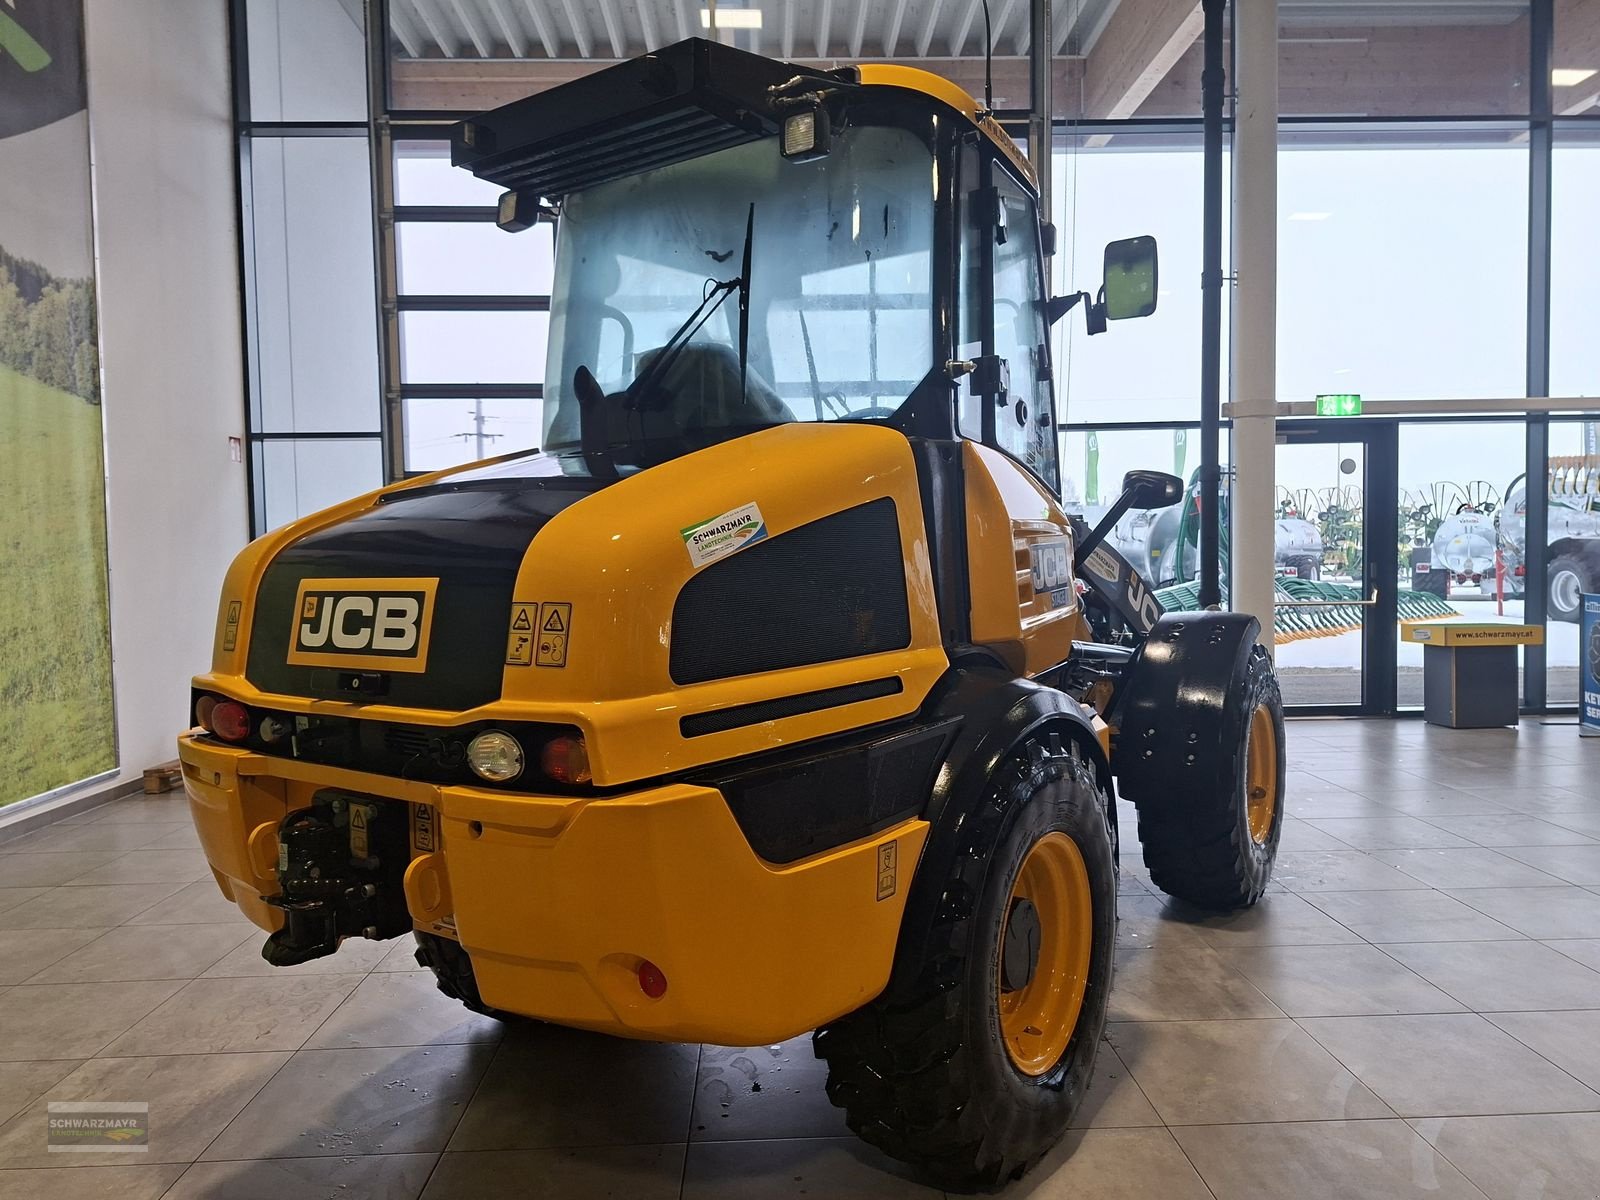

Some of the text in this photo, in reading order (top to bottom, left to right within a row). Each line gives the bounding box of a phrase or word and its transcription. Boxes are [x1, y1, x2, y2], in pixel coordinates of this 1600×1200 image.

[692, 514, 753, 545] SCHWARZMAYR
[697, 533, 734, 552] LANDTECHNIK
[1127, 582, 1159, 632] JC
[301, 597, 419, 651] JCB
[1455, 631, 1533, 639] www.schwarzmayr.at
